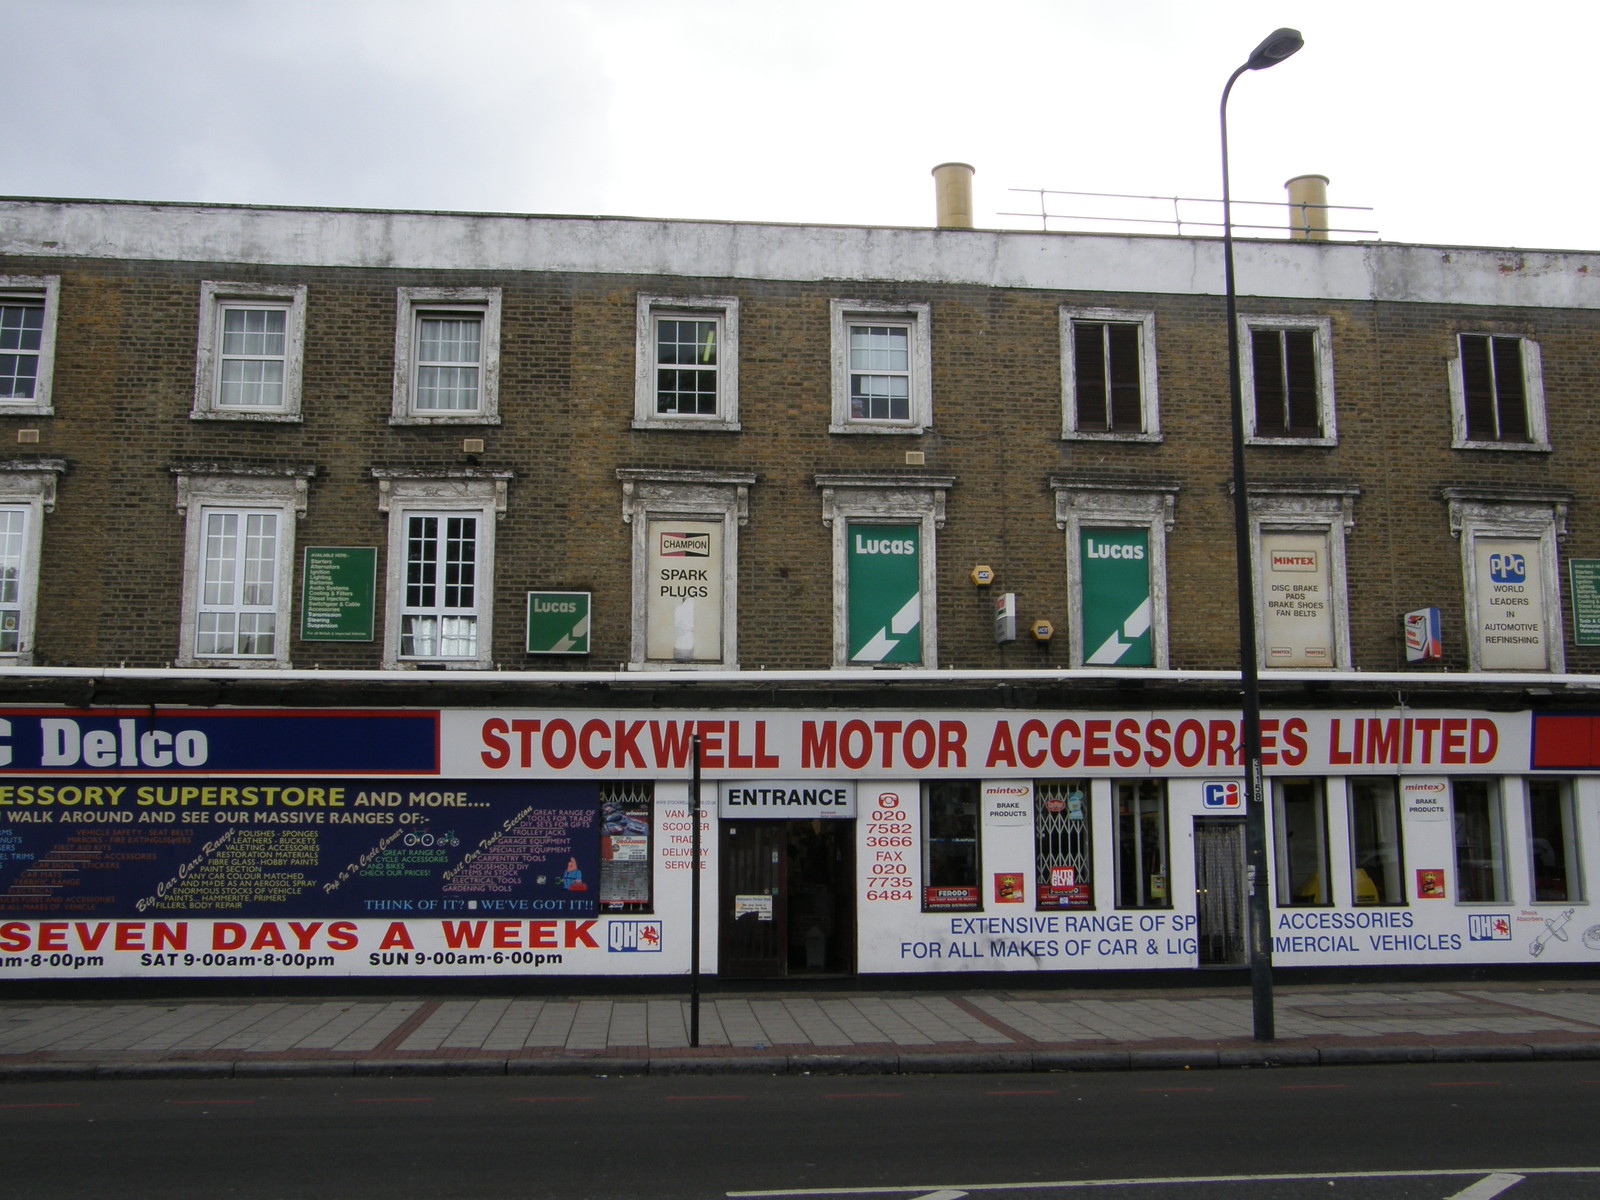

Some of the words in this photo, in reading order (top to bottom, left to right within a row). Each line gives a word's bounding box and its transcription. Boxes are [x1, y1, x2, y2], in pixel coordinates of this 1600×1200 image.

[663, 540, 707, 550] CHAMPION
[856, 534, 915, 554] Lucas
[1087, 538, 1144, 560] Lucas
[1273, 557, 1315, 566] MINTEX
[661, 569, 708, 581] SPARK
[660, 586, 708, 598] PLUGS
[1271, 584, 1290, 592] DISC
[1493, 585, 1525, 593] WORLD
[534, 598, 577, 613] Lucas
[1268, 601, 1294, 609] BRAKE
[1490, 597, 1529, 606] LEADERS
[1293, 610, 1317, 618] BELTS
[1506, 611, 1515, 619] IN
[1484, 623, 1538, 632] AUTOMOTIVE
[1485, 636, 1539, 644] REFINISHING
[40, 718, 209, 767] Delco
[480, 718, 780, 770] STOCKWELL
[801, 719, 968, 770] MOTOR
[985, 718, 1308, 769] ACCESSORIES
[1329, 718, 1499, 765] LIMITED
[986, 787, 1023, 795] mintex
[0, 786, 127, 806] ESSORY
[136, 787, 345, 806] SUPERSTORE
[354, 792, 402, 807] AND
[409, 792, 490, 808] MORE....
[728, 789, 847, 806] ENTRANCE
[7, 811, 54, 823] WALK
[59, 811, 134, 824] AROUND
[138, 811, 176, 823] AND
[182, 811, 209, 824] SEE
[214, 811, 250, 824] OUR
[254, 811, 325, 824] MASSIVE
[329, 812, 394, 824] RANGES
[665, 810, 685, 818] VAN
[872, 810, 906, 821] 020
[663, 823, 710, 831] SCOOER
[866, 823, 912, 834] 7582
[545, 829, 566, 837] JACKS
[442, 862, 465, 880] Visit
[464, 849, 482, 864] Our
[479, 831, 503, 849] Tools
[503, 805, 534, 833] Section
[866, 836, 912, 847] 3666
[323, 880, 340, 894] Pop
[338, 871, 350, 881] In
[347, 863, 359, 873] To
[360, 847, 379, 867] Cycle
[379, 828, 404, 850] Corner
[876, 851, 903, 861] FAX
[136, 896, 156, 912] Big
[157, 877, 178, 897] Car
[178, 854, 204, 879] Care
[202, 828, 236, 856] Range
[872, 863, 907, 875] 020
[1052, 869, 1074, 878] AUTO
[867, 877, 913, 888] 7735
[867, 890, 913, 901] 6484
[364, 900, 413, 910] THINK
[417, 900, 442, 910] OF
[442, 900, 464, 910] IT?
[481, 900, 529, 910] WE'VE
[533, 900, 569, 910] GOT
[570, 900, 593, 910] IT!!
[951, 917, 1059, 935] EXTENSIVE
[1065, 915, 1133, 934] RANGE
[1139, 914, 1166, 932] OF
[1278, 911, 1414, 931] ACCESSORIES
[1469, 915, 1492, 940] QH
[0, 921, 188, 952] SEVEN
[212, 921, 359, 951] DAYS
[379, 921, 415, 950] A
[441, 920, 600, 949] WEEK
[609, 921, 638, 952] QH
[1369, 933, 1461, 952] VEHICLES
[901, 942, 942, 959] FOR
[948, 941, 985, 958] ALL
[990, 940, 1059, 957] MAKES
[1064, 939, 1092, 956] OF
[1098, 938, 1138, 955] CAR
[1146, 938, 1159, 954] &
[140, 953, 179, 967] SAT
[183, 953, 335, 970] 9-00am-8-00pm
[369, 952, 410, 966] SUN
[415, 951, 563, 968] 9-00am-6-00pm
